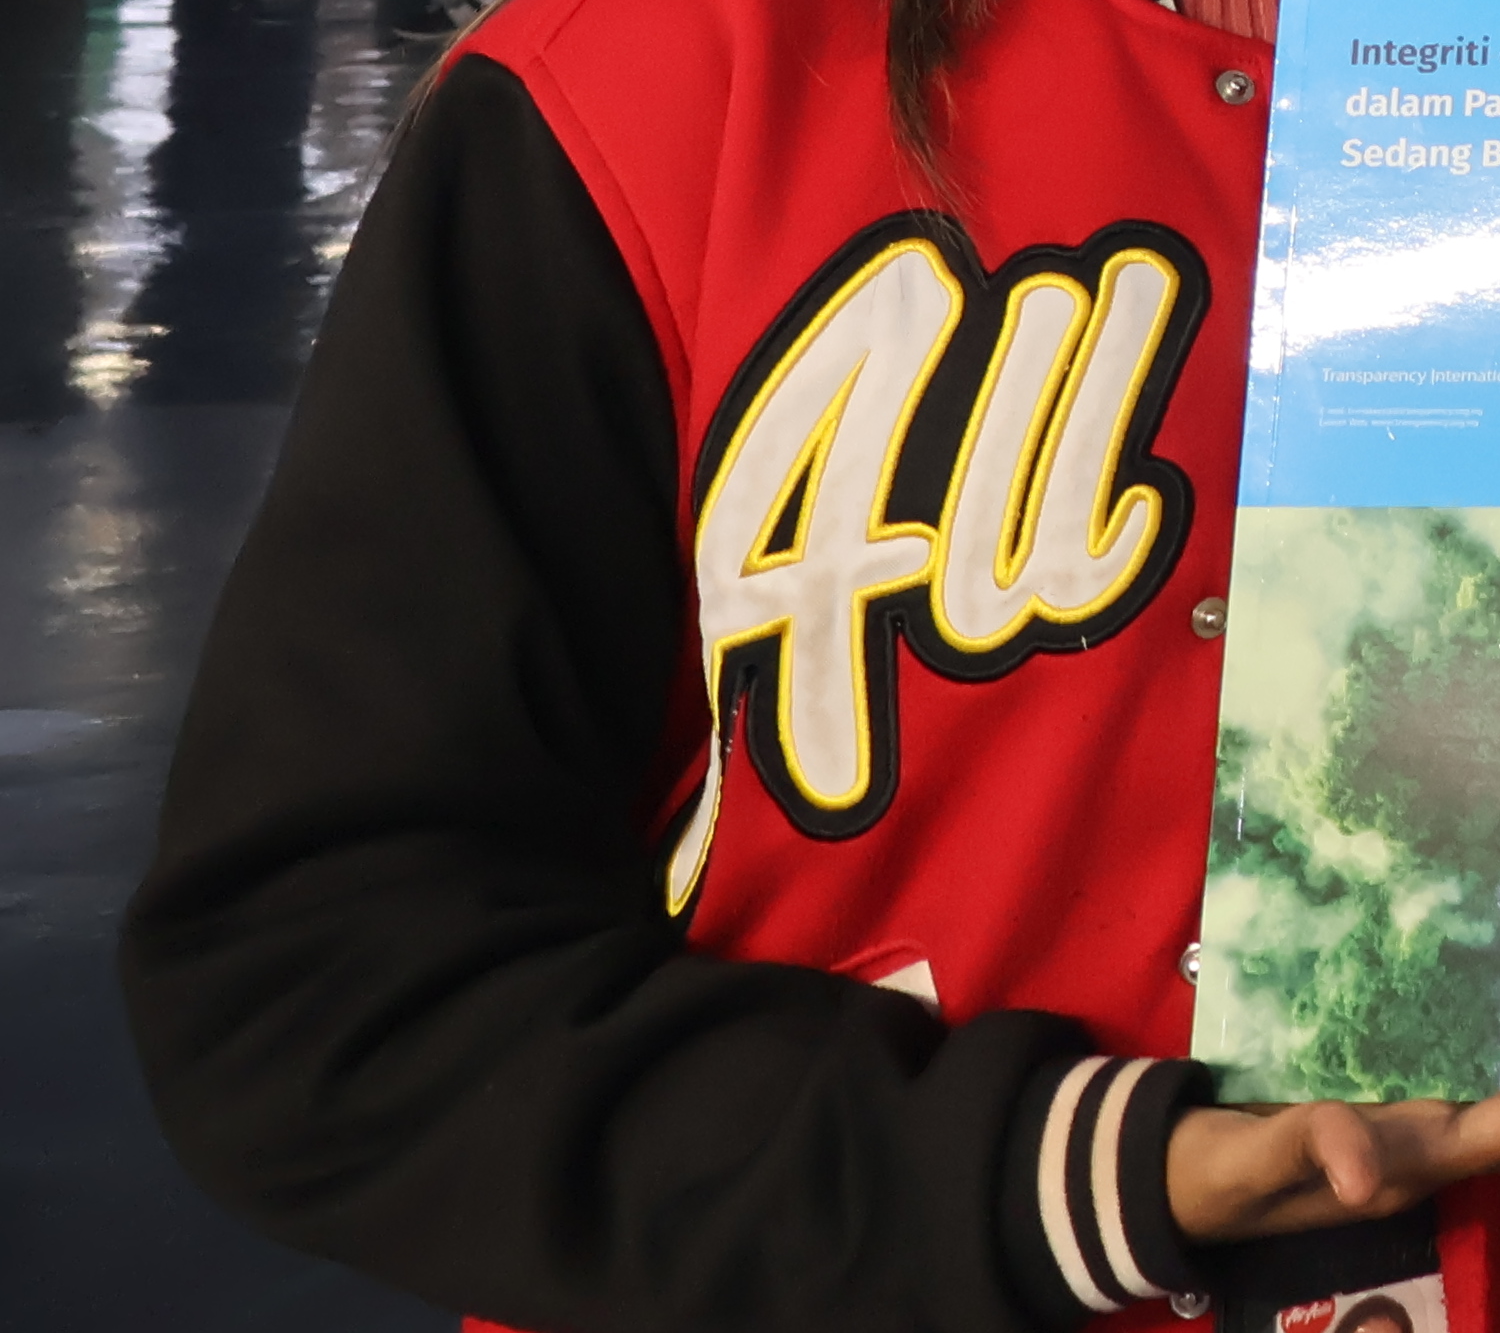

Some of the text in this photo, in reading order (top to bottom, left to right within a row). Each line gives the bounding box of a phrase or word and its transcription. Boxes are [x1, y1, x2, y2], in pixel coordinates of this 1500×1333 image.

[1352, 36, 1489, 73] Integriti
[1345, 87, 1454, 117] dalam
[1341, 138, 1472, 175] Sedang
[1322, 367, 1426, 385] Transparency
